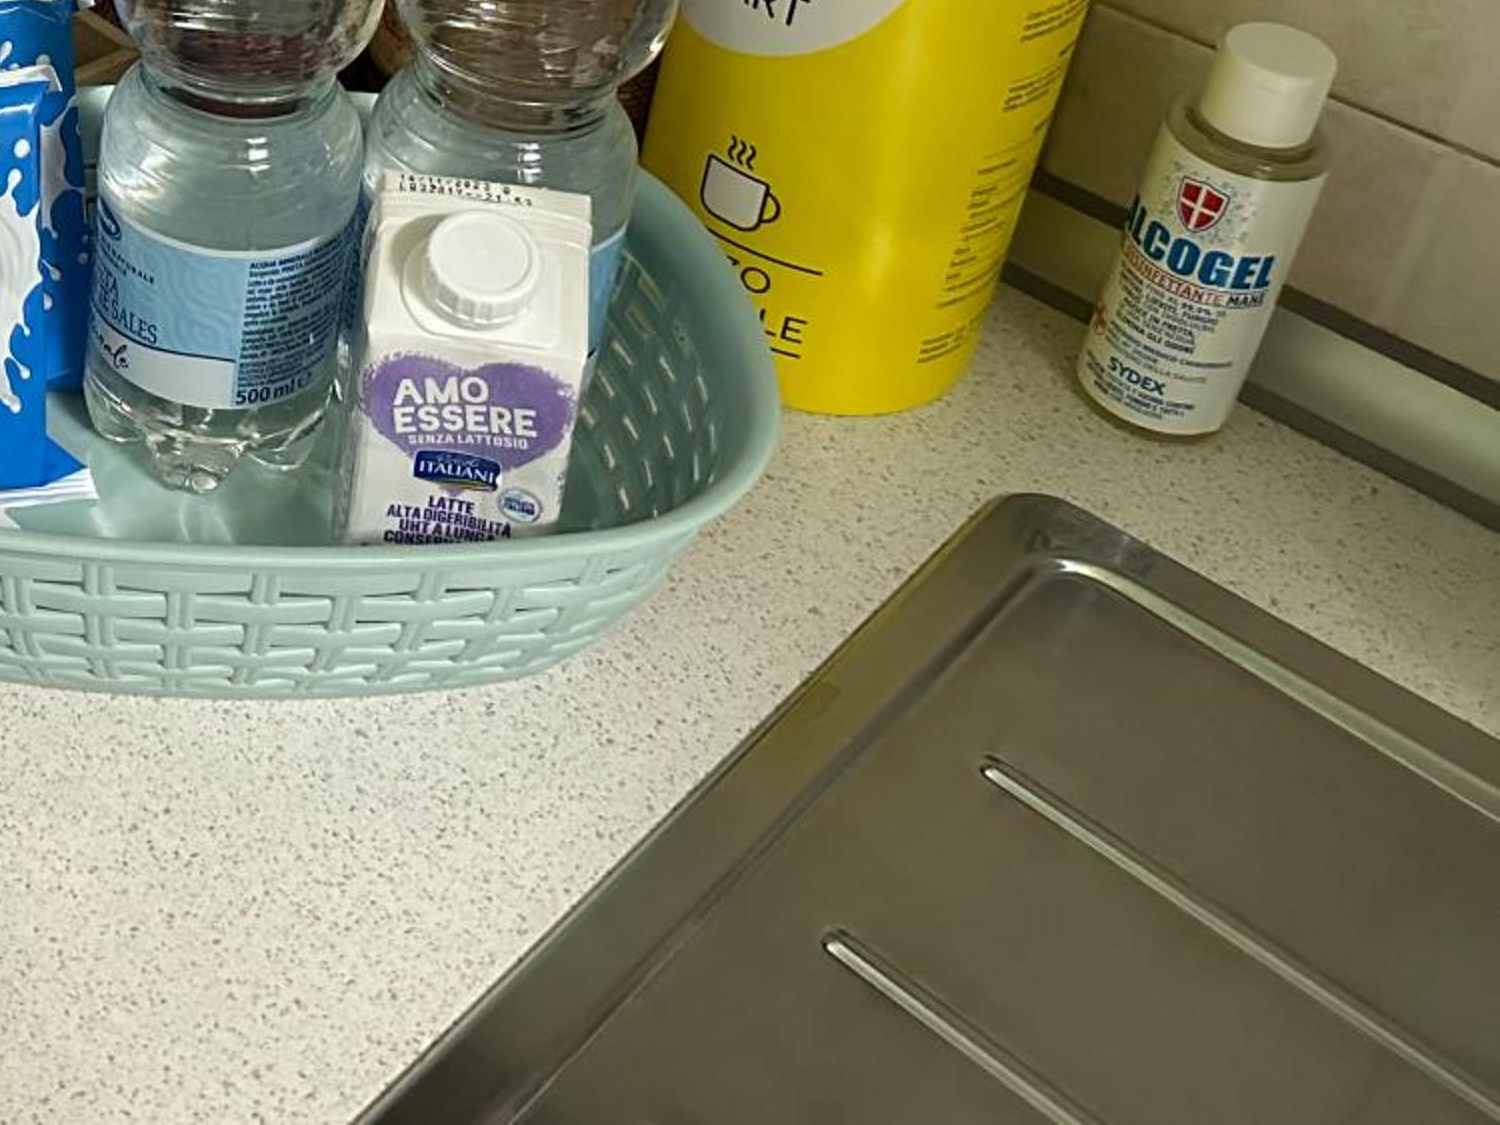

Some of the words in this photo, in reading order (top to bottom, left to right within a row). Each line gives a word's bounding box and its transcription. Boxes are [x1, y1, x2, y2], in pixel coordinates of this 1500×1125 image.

[1226, 289, 1264, 308] MANI
[1106, 355, 1166, 397] SYDEX
[235, 387, 271, 406] 500
[273, 376, 295, 399] ml
[393, 376, 489, 406] AMO
[393, 404, 538, 438] ESSERE
[419, 460, 494, 485] ITALIANI
[386, 503, 421, 518] ALTA
[428, 495, 476, 515] LATTE
[399, 518, 429, 533] UHT
[431, 523, 443, 536] A
